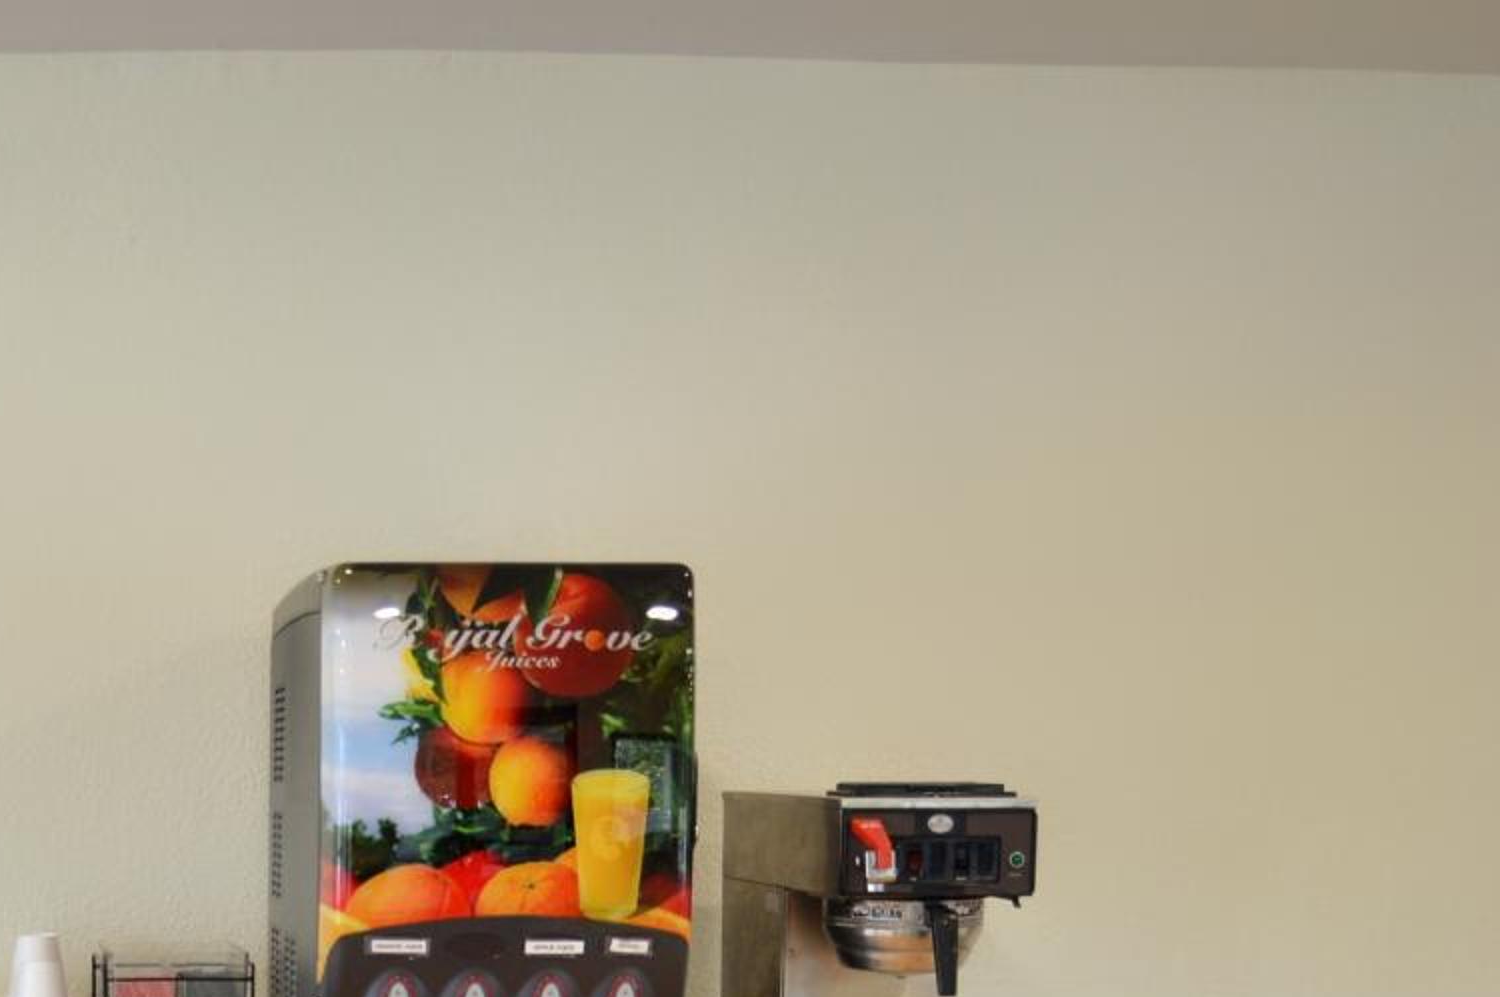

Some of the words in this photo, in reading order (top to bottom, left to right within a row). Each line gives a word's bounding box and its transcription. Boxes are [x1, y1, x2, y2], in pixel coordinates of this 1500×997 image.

[372, 609, 524, 660] Royal
[526, 614, 655, 651] Grove
[483, 651, 560, 671] Juices
